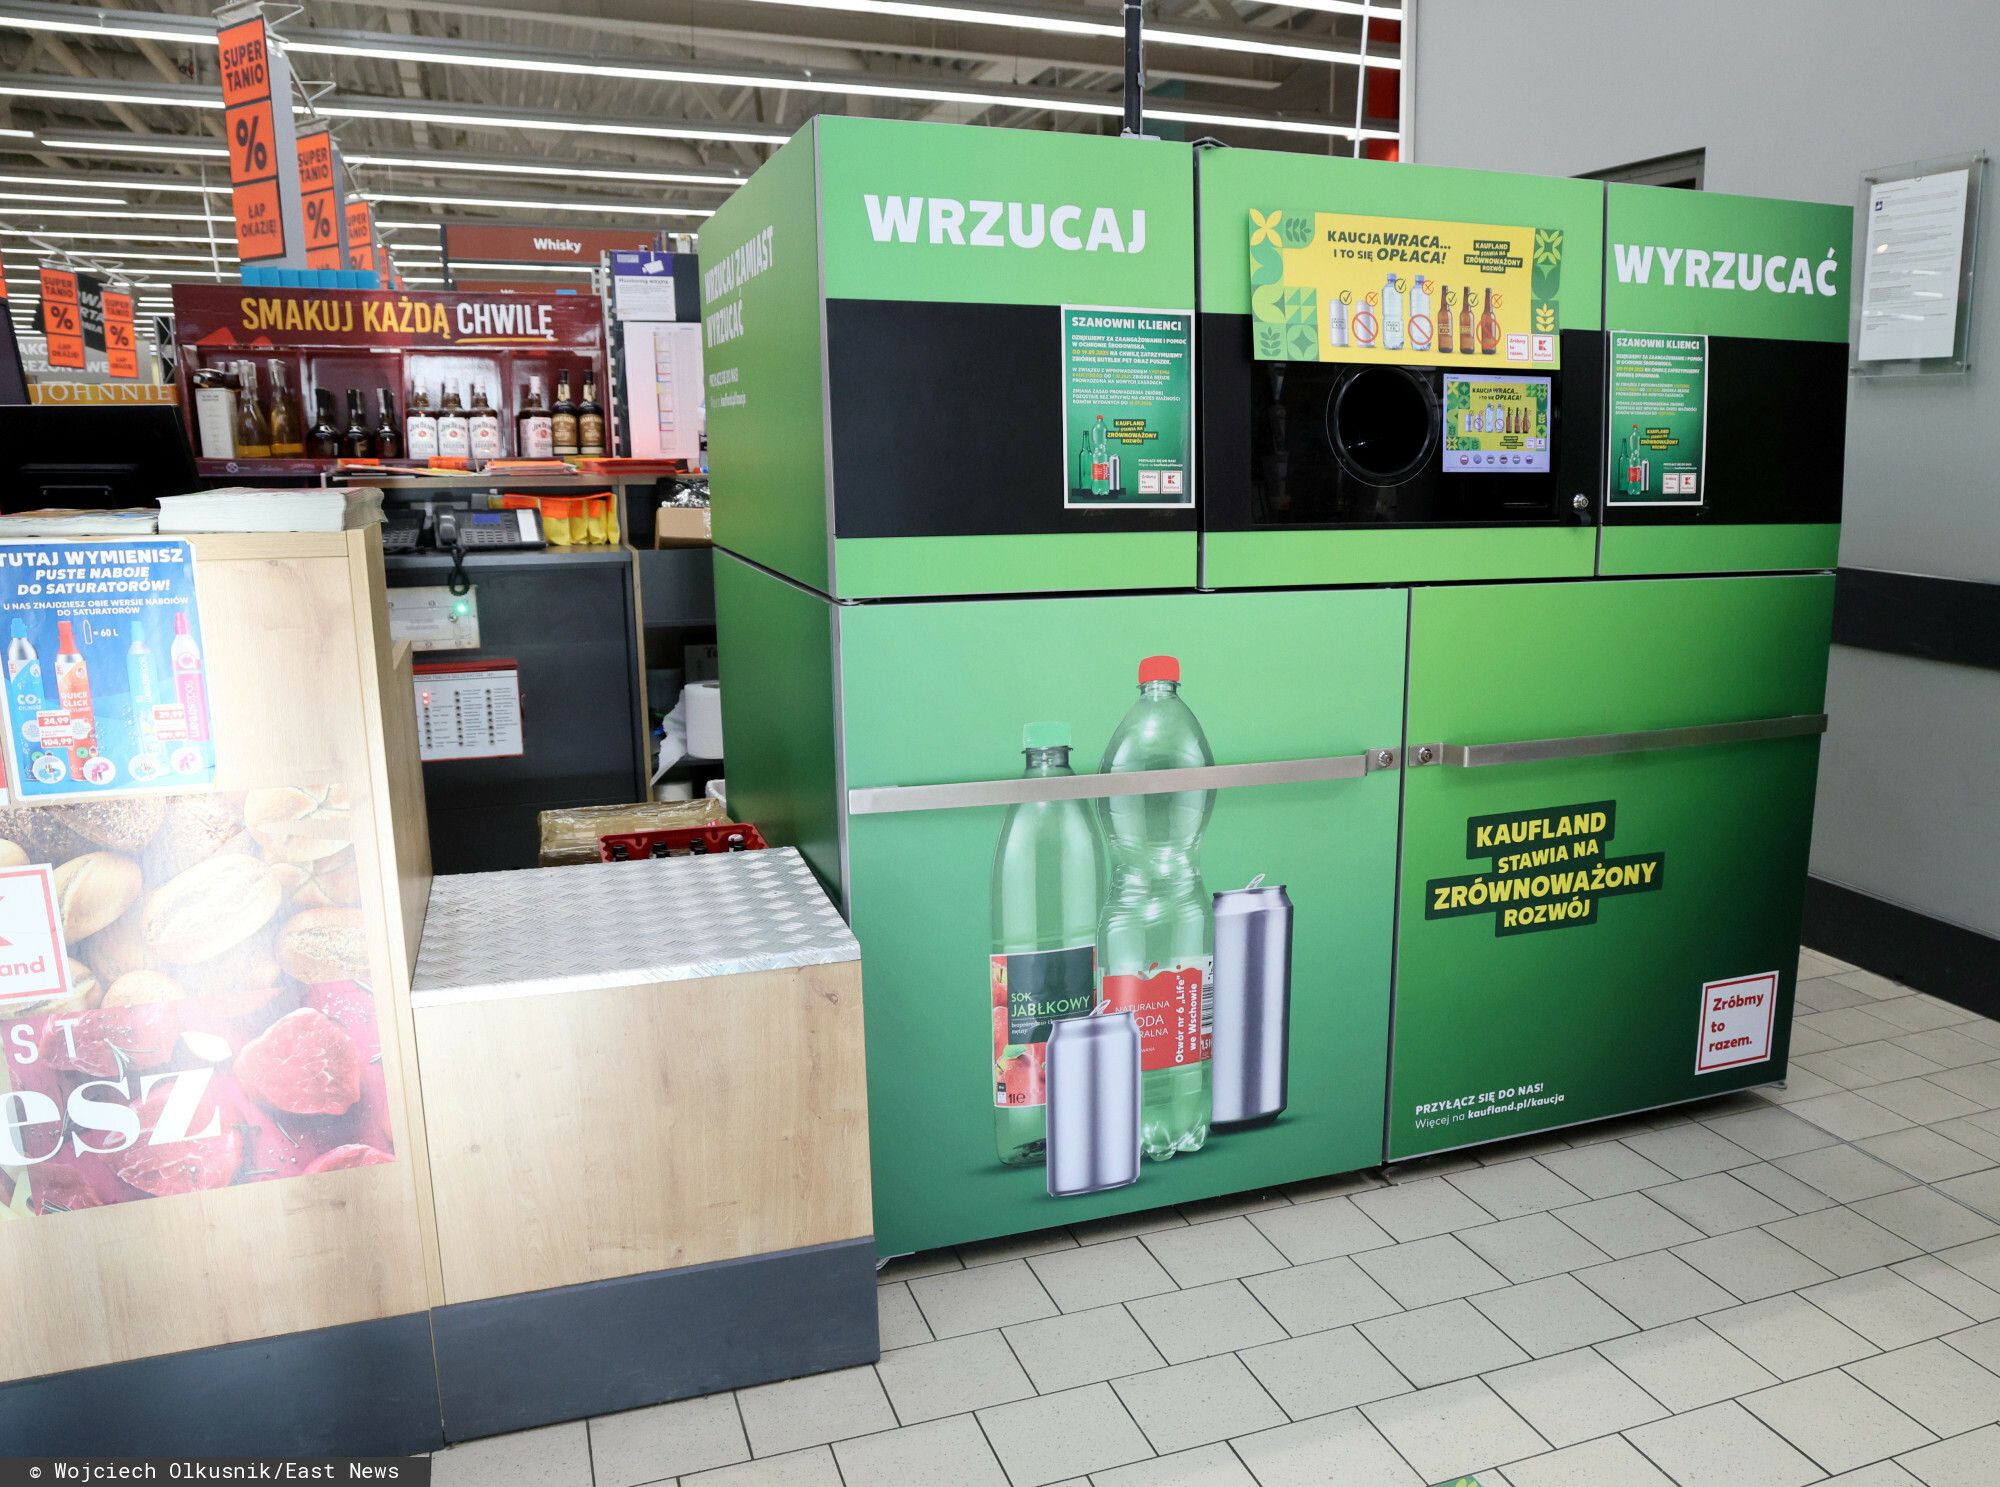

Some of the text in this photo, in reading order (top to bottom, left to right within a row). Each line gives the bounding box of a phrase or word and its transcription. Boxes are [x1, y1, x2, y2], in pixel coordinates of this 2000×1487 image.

[224, 39, 262, 70] SUPER
[226, 63, 264, 92] TANIO
[236, 116, 267, 172] %
[298, 147, 328, 168] SUPER
[300, 164, 328, 182] TANIO
[306, 199, 330, 239] %
[864, 194, 1145, 254] WRZUCAJ
[533, 238, 581, 253] Whisky
[1328, 230, 1451, 250] KAUCJA WRACA...
[735, 225, 773, 288] ZAMIAST
[1340, 250, 1354, 259] TO
[1357, 251, 1372, 262] SIĘ
[1377, 249, 1447, 264] OPŁACA!
[1466, 255, 1521, 266] ZRÓWNOWAŻONY
[1614, 244, 1838, 296] WYRZUCAĆ
[242, 297, 554, 340] SMAKUJ KAŻDĄ CHWILĘ
[1072, 317, 1182, 330] SZANOWNI KLIENCI
[1616, 338, 1700, 349] SZANOWNI KLIENCI
[34, 384, 171, 404] JOHNNIE
[0, 548, 184, 567] TUTAJ WYMIENISZ
[36, 566, 150, 580] PUSTE NABOJE
[18, 580, 170, 595] DO SATURATORÓW!
[33, 600, 86, 609] ZNAJDZIESZ
[73, 606, 140, 616] SATURATORÓW
[1476, 812, 1606, 848] KAUFLAND
[1498, 839, 1599, 874] STAWIA NA
[1434, 861, 1657, 910] ZRÓWNOWAŻONY
[1504, 896, 1590, 928] ROZWÓJ
[1011, 992, 1031, 1002] SOK
[1011, 995, 1090, 1017] JABŁKOWY
[1115, 1001, 1170, 1013] NATURALNA
[1712, 991, 1764, 1012] Zróbmy
[1135, 1015, 1164, 1028] ODA
[1178, 1017, 1184, 1028] nr
[1188, 983, 1198, 1051] we Wschowie
[1711, 1020, 1725, 1033] to
[1139, 1028, 1168, 1038] RALNA
[1176, 1030, 1185, 1063] Otwór
[1708, 1036, 1752, 1052] razem.
[1415, 1082, 1544, 1116] PRZYŁĄCZ SIĘ DO NAS!
[1415, 1092, 1565, 1130] Więcej na kaufland.pl/kaucja
